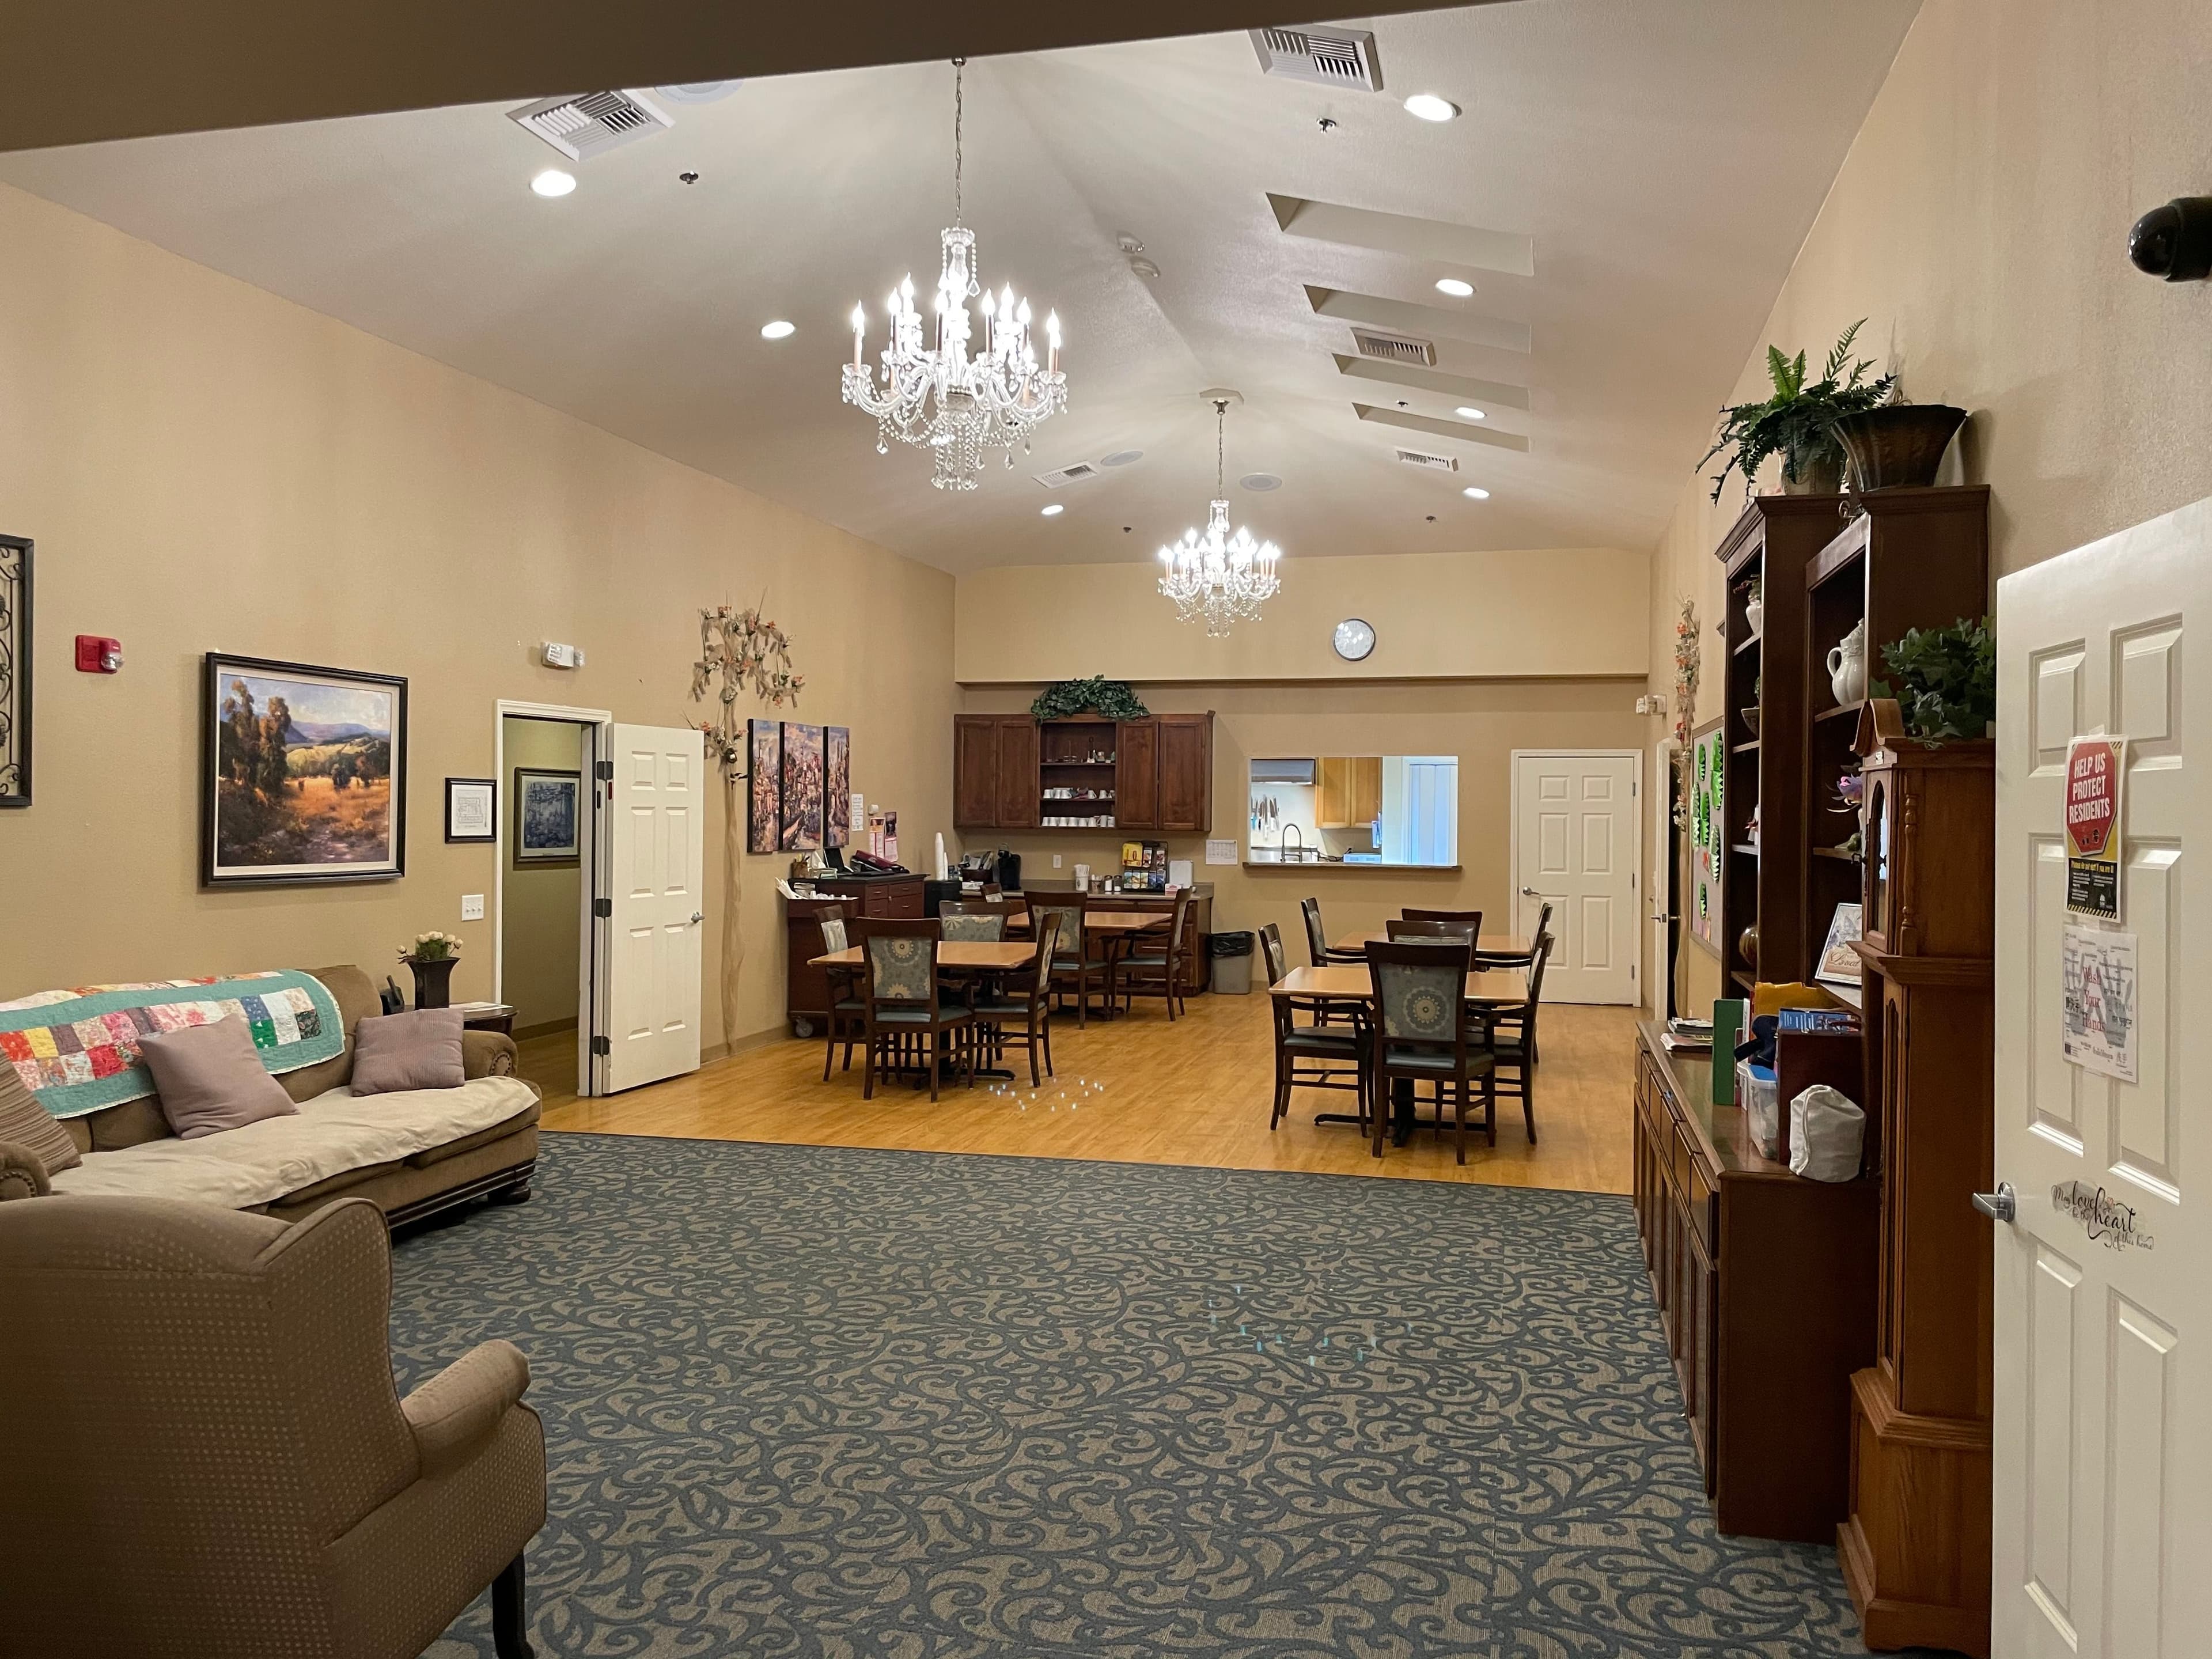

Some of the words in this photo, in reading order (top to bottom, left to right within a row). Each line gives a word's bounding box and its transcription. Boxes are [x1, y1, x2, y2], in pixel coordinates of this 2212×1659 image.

[2074, 756, 2093, 779] HELP
[2094, 752, 2106, 774] US
[2073, 775, 2106, 801] PROTECT
[2069, 797, 2110, 824] RESIDENTS
[2082, 966, 2101, 985] Wash
[2084, 988, 2101, 1007] Your
[2082, 1012, 2105, 1032] Hands
[2072, 1180, 2094, 1209] love
